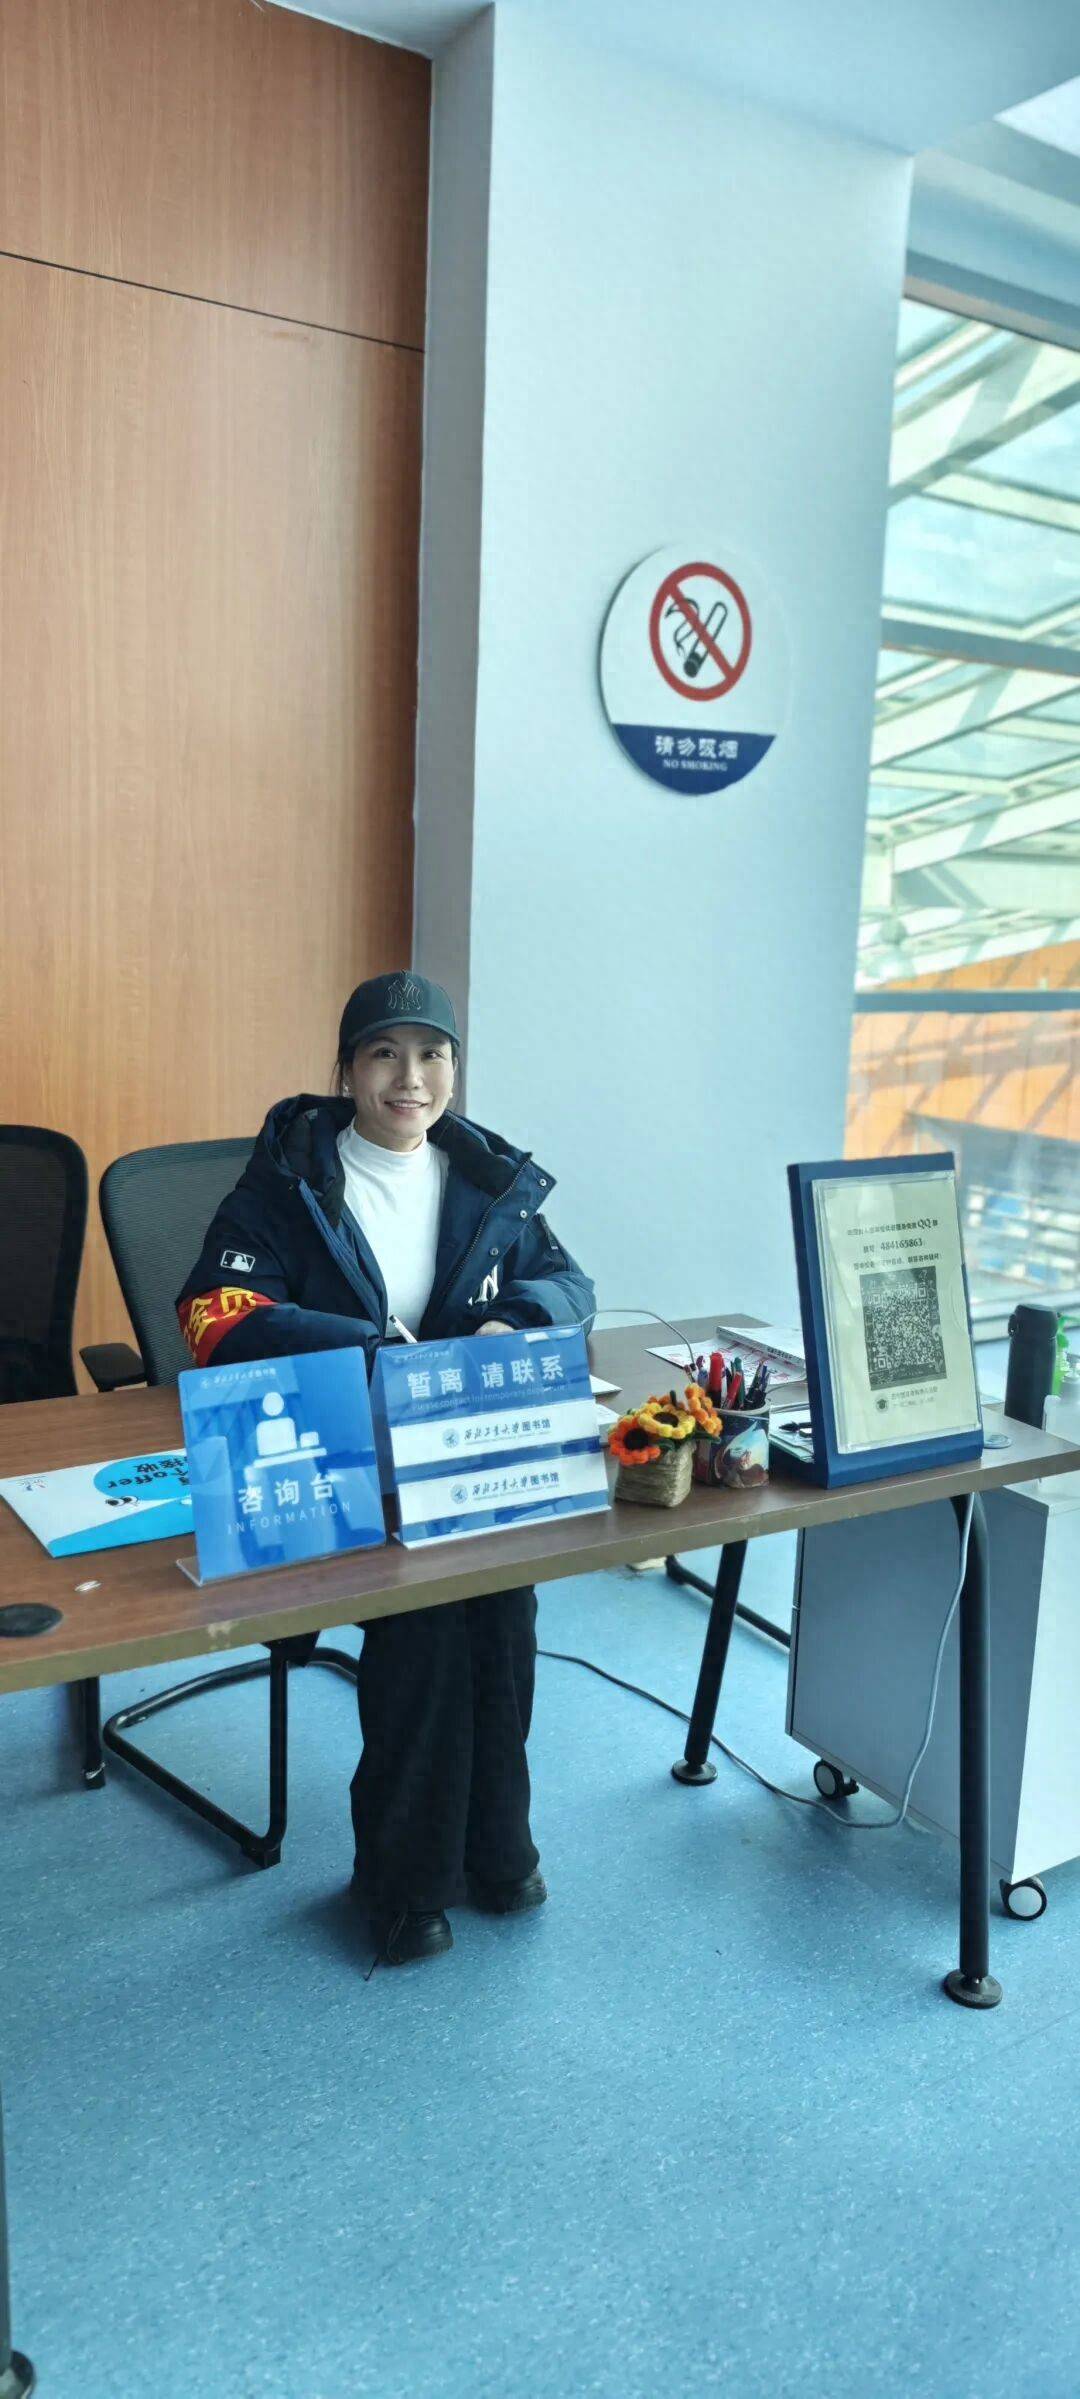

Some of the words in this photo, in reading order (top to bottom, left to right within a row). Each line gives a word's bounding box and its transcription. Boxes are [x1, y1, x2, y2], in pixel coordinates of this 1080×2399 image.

[654, 735, 739, 759] 请勿吸烟
[662, 758, 679, 769] NO
[680, 760, 729, 772] SMOKING
[406, 1367, 463, 1399] 暂离
[481, 1354, 564, 1389] 请联系
[108, 1471, 173, 1490] offer
[237, 1472, 334, 1514] 咨询台
[226, 1501, 351, 1536] INFORMATION
